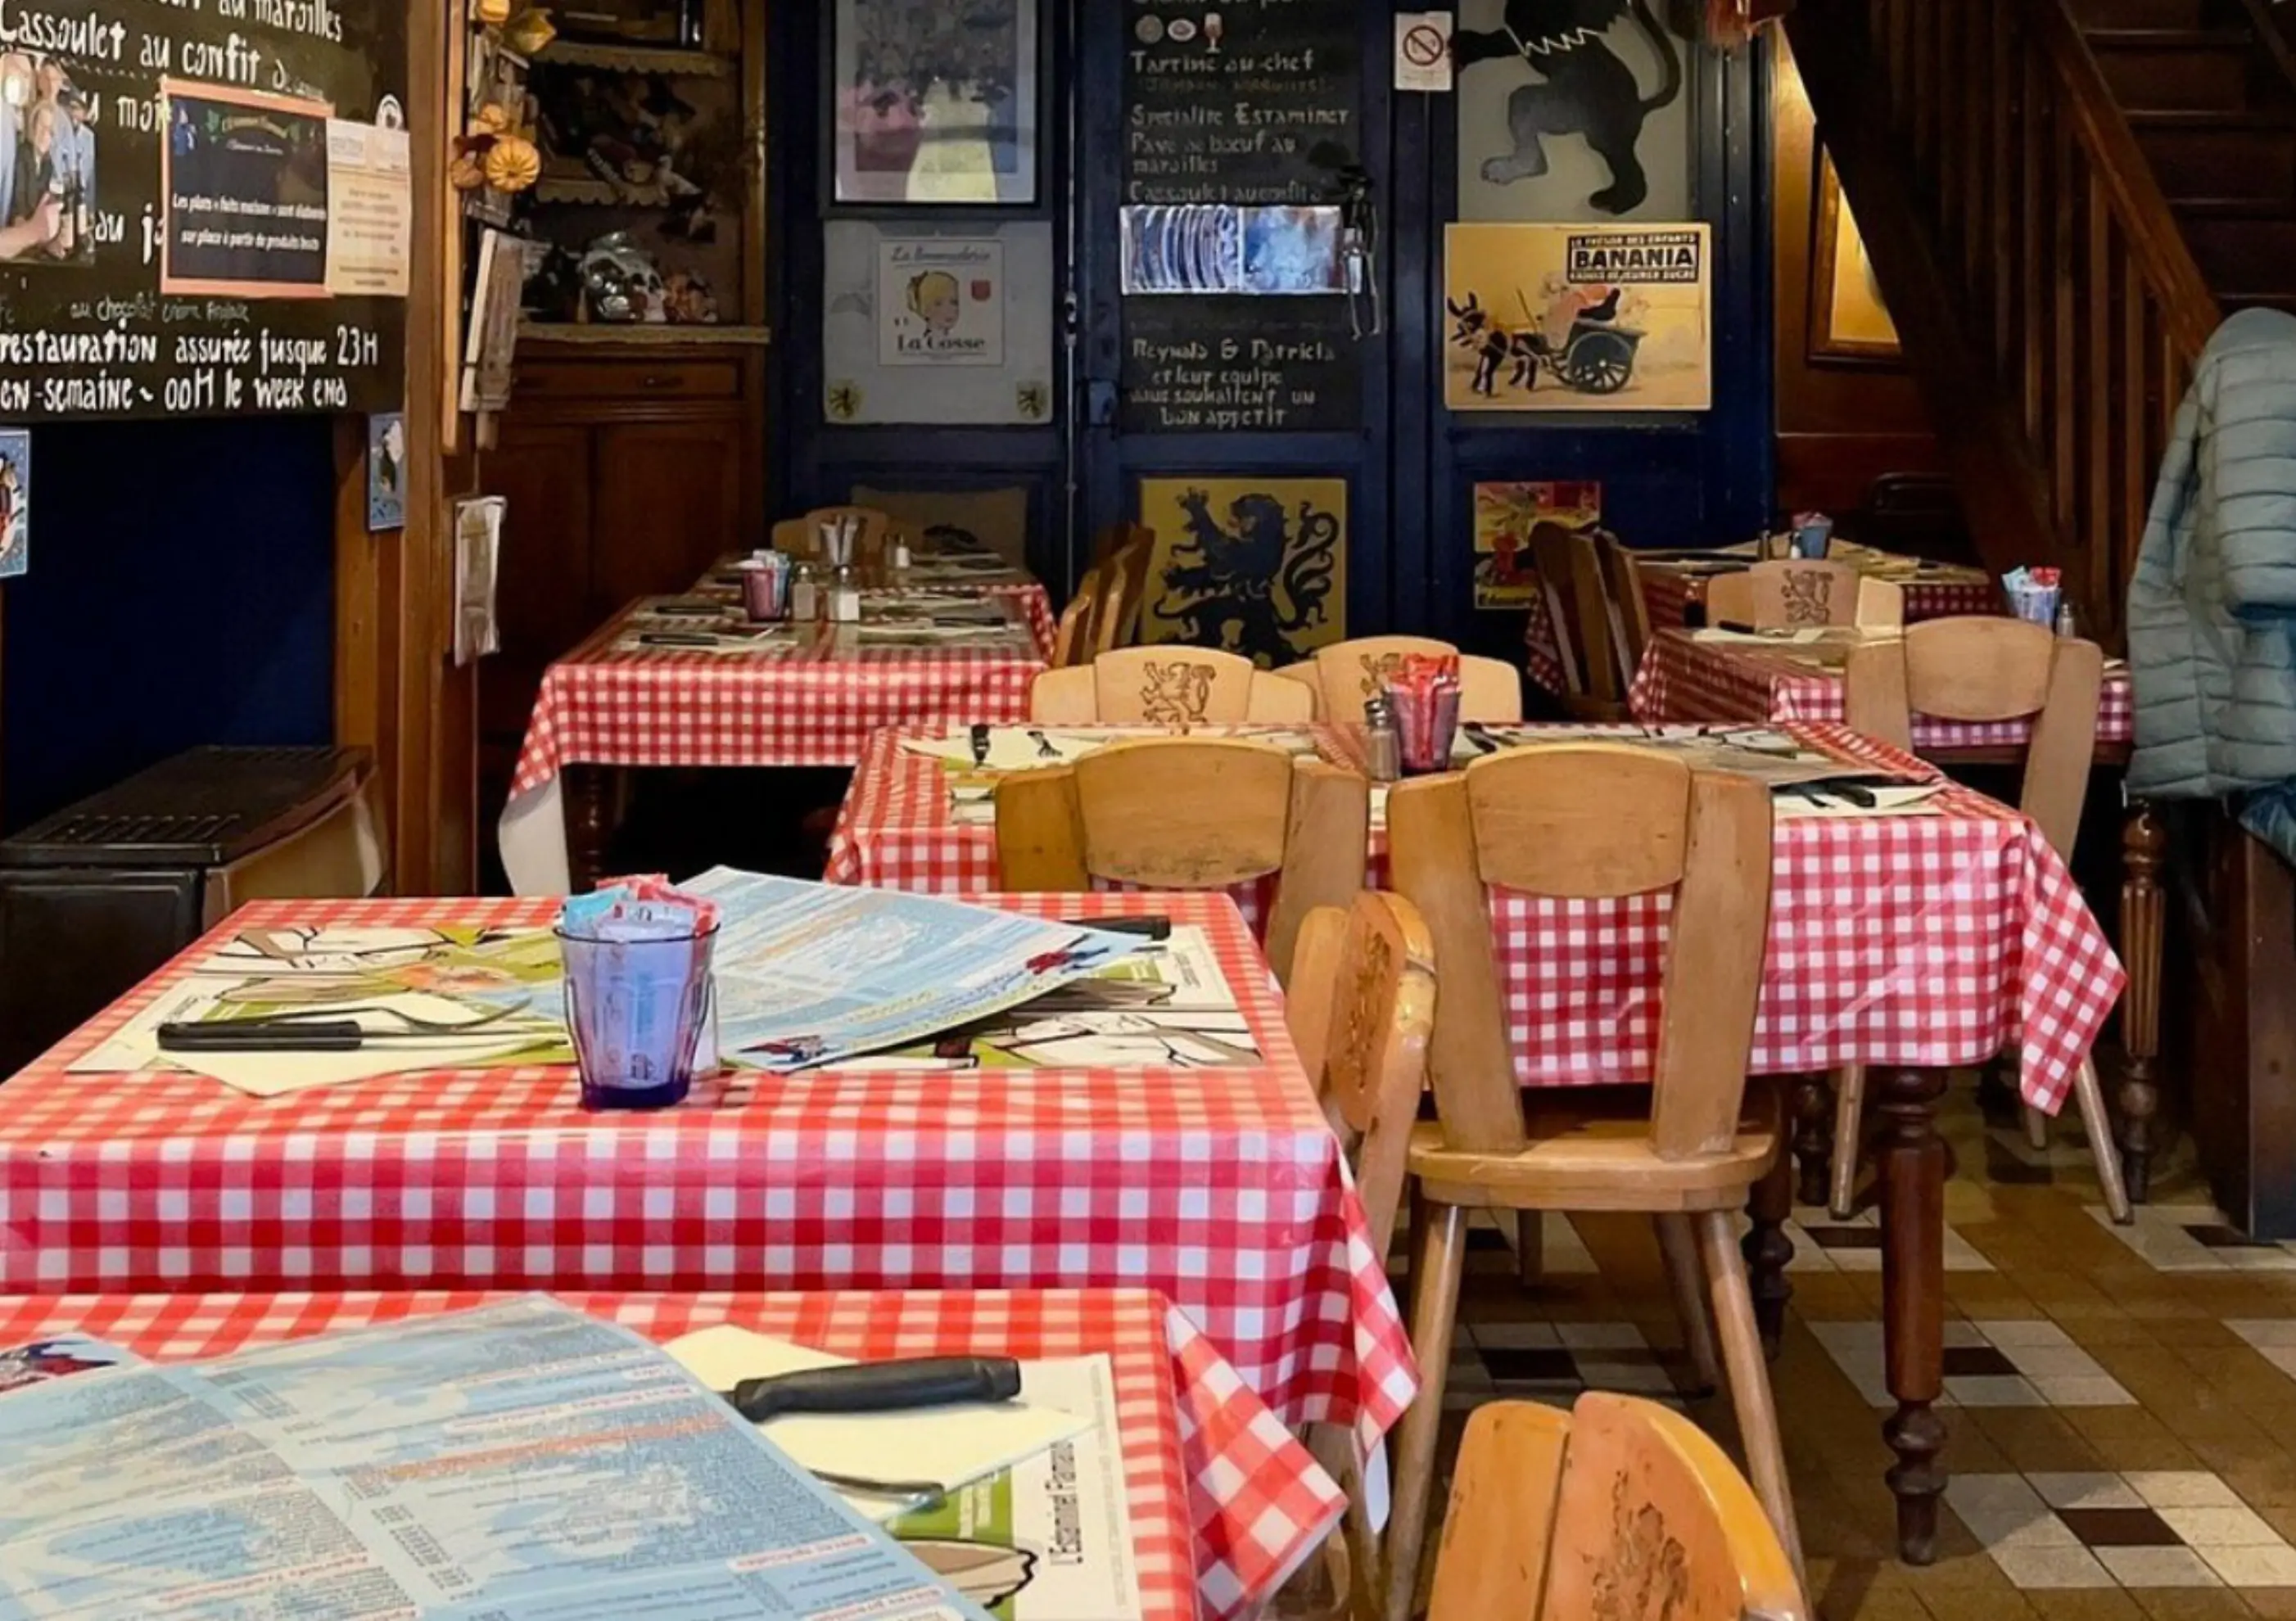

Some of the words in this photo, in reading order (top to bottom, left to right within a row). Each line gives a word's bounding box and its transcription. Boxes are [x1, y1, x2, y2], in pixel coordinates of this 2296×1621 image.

[0, 0, 126, 61] Cassoulet
[140, 34, 170, 68] au
[182, 33, 260, 84] confit
[172, 193, 188, 209] Les
[188, 194, 212, 214] plats
[1575, 247, 1693, 268] BANANIA
[260, 327, 327, 375] jusque
[337, 324, 378, 366] 23H
[224, 368, 242, 410] le
